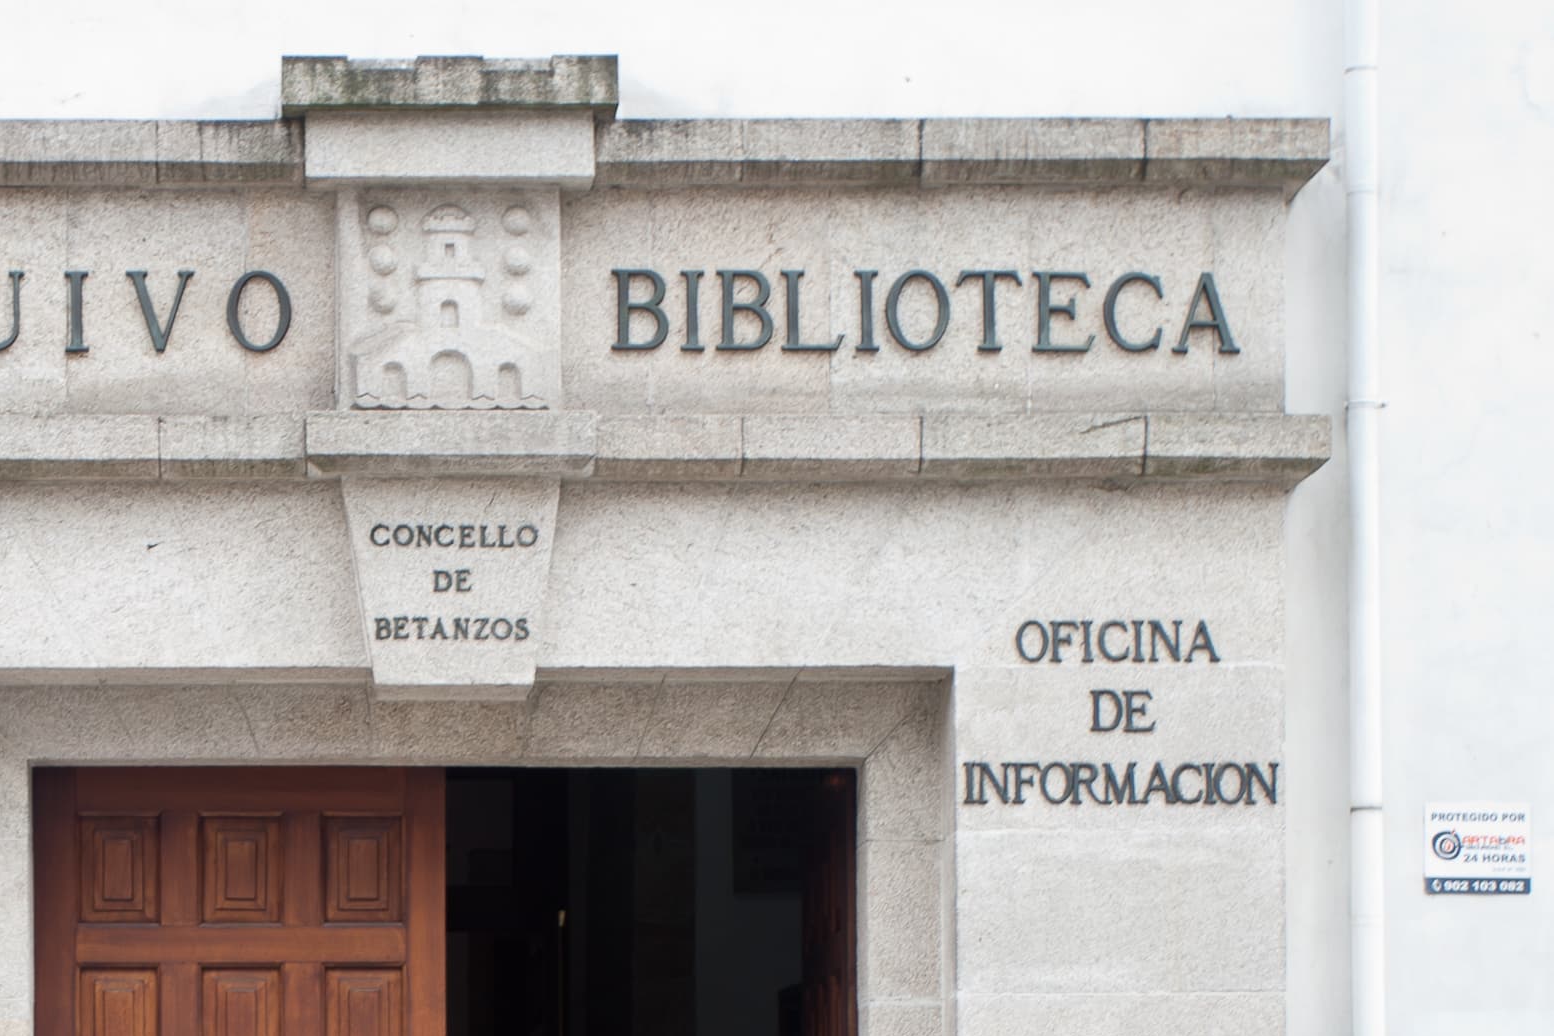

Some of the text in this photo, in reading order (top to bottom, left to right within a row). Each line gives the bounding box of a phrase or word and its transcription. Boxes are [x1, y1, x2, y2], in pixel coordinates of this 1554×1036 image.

[610, 269, 1240, 359] BIBLIOTECA
[370, 523, 539, 549] CONCELLO
[433, 569, 471, 593] DE
[374, 616, 530, 642] BETANZOS
[1015, 620, 1221, 664] OFICINA
[1090, 689, 1156, 734] DE
[963, 762, 1279, 806] INFORMACION
[1431, 812, 1526, 822] PROTEGIDO POR
[1463, 853, 1526, 863] 24 HORAS
